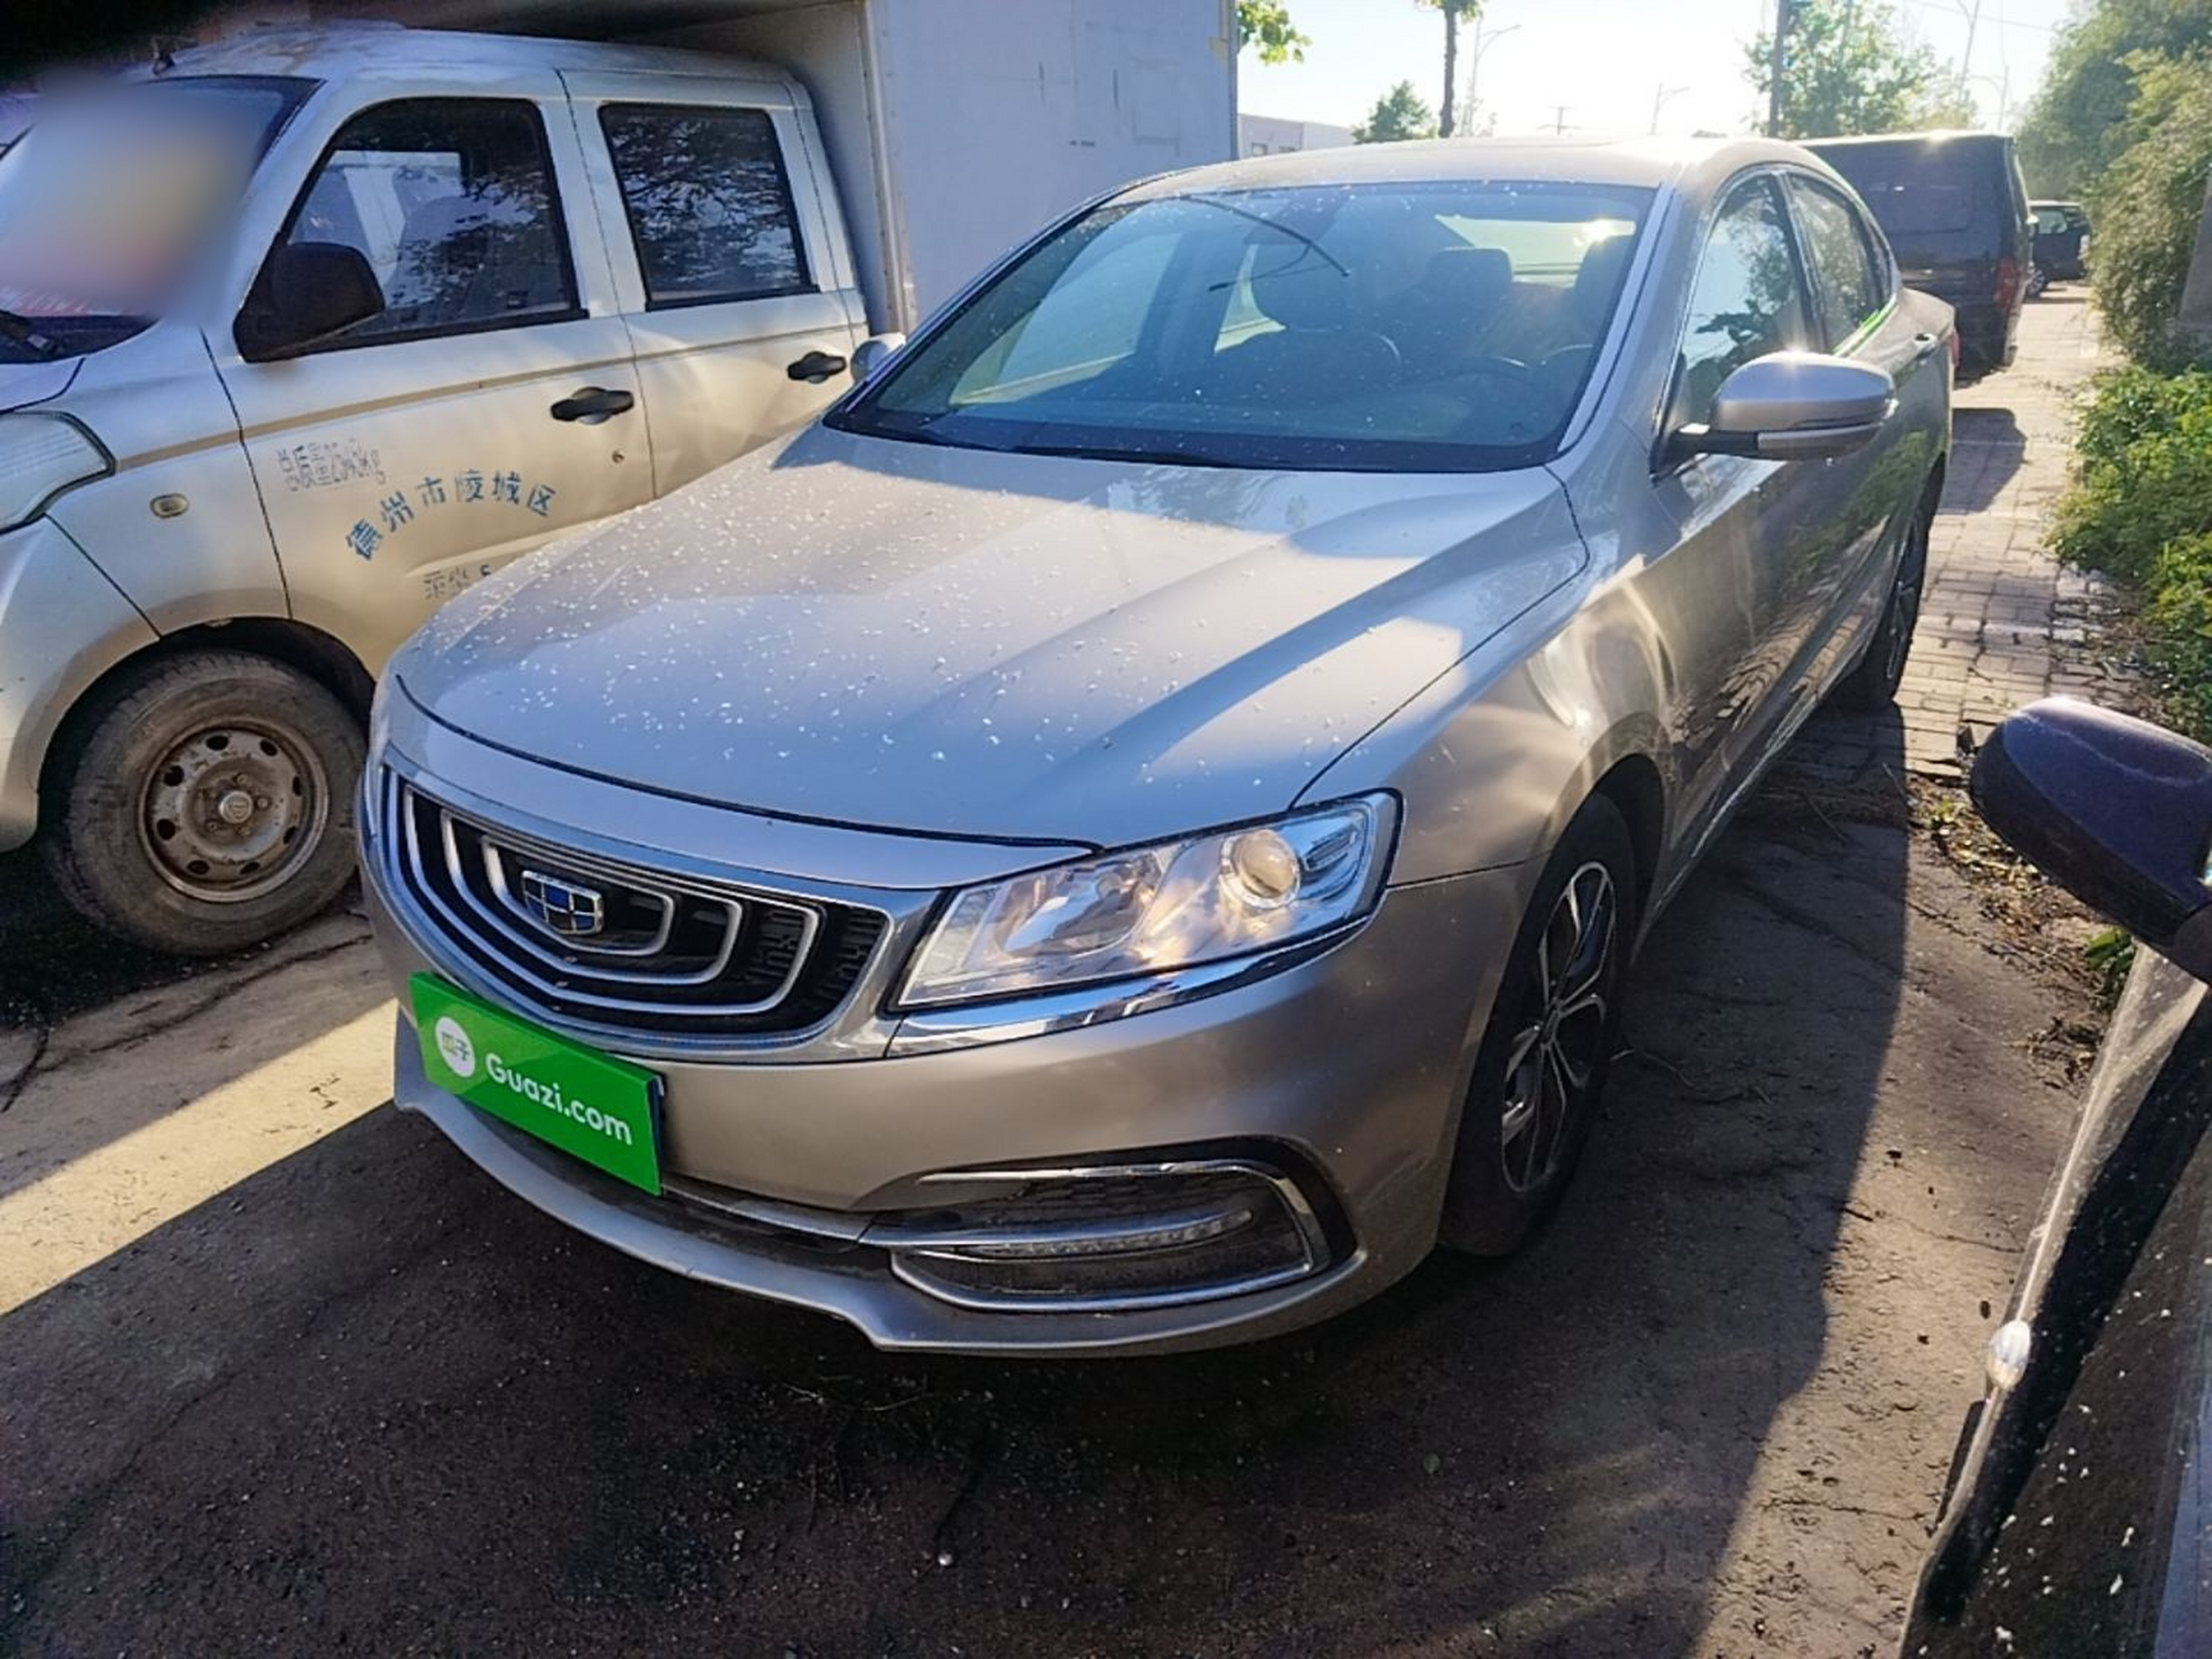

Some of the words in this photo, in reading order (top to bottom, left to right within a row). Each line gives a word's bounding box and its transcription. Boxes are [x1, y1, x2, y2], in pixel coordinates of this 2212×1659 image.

[346, 469, 556, 560] 德州市陵城区
[485, 1052, 632, 1145] Guazi.com
